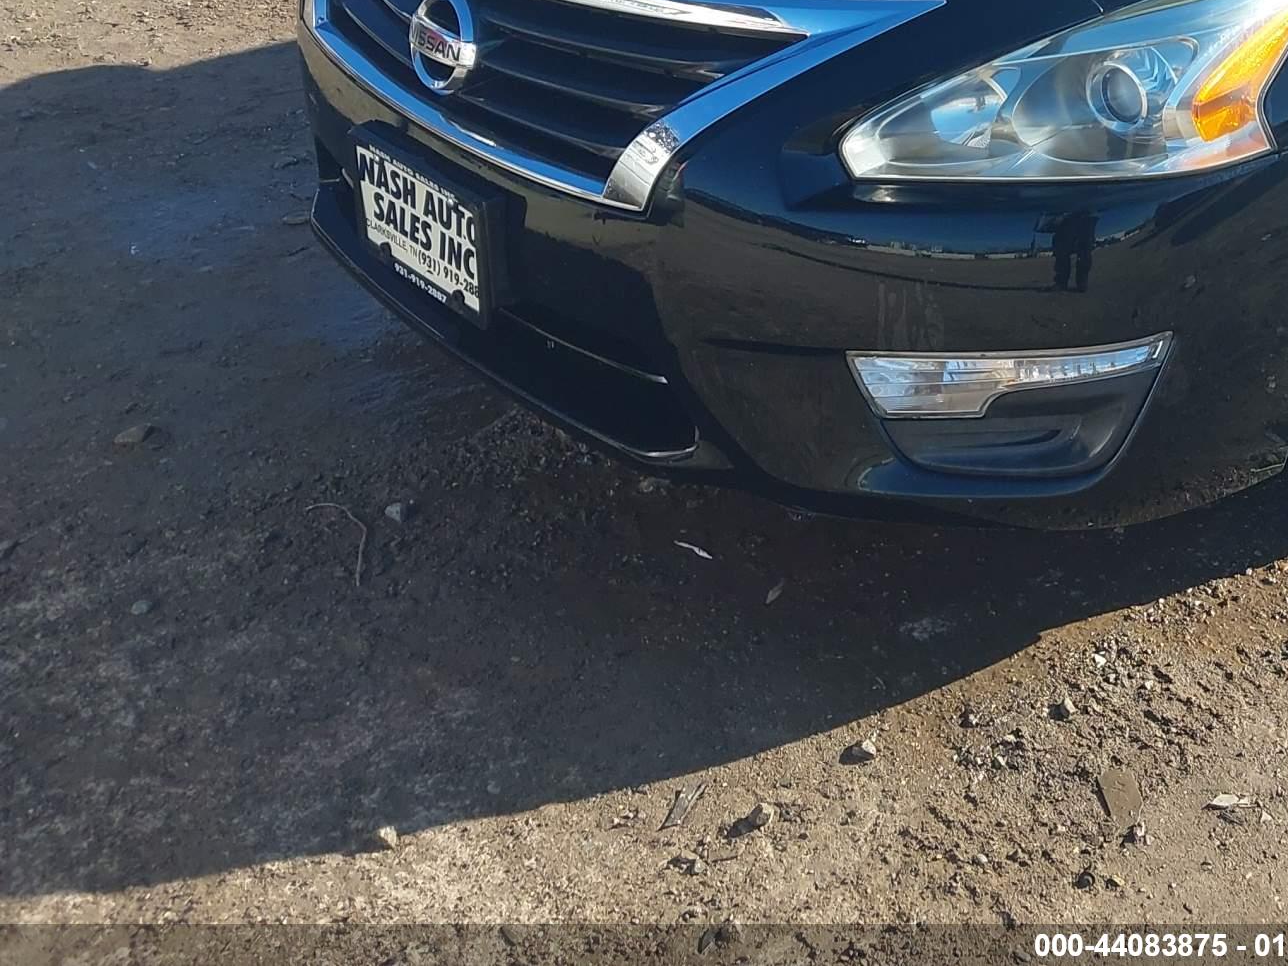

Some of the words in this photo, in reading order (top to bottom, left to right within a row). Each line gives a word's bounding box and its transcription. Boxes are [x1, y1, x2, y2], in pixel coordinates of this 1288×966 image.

[411, 19, 461, 62] NISSAN
[358, 152, 416, 210] NASH
[423, 190, 477, 248] AUTO
[373, 191, 432, 251] SALES
[439, 230, 476, 280] INC
[408, 244, 418, 258] TN
[418, 249, 441, 276] (931)
[443, 265, 480, 299] 919-288
